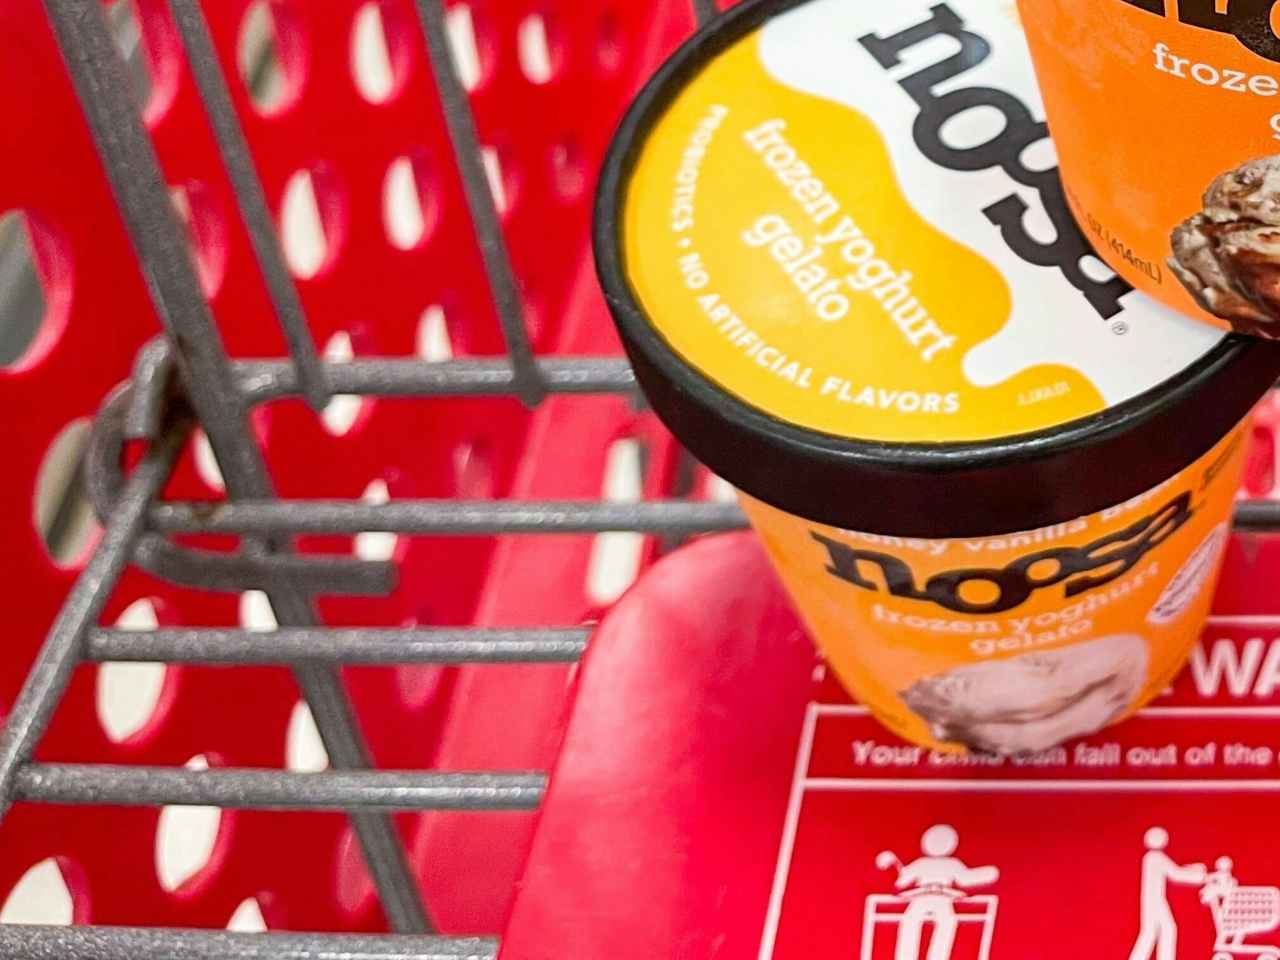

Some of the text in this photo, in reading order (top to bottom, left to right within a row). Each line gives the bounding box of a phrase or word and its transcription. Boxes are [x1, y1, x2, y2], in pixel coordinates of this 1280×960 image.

[671, 104, 961, 416] PROBIOTICS NO ARTIFICIAL FLAVORS
[741, 119, 959, 363] frozen yoghurt
[741, 212, 850, 323] gelato
[810, 489, 1195, 615] noosa
[869, 602, 1000, 634] frozen
[1005, 561, 1159, 638] yoghurt
[970, 619, 1093, 656] gelato
[853, 741, 920, 766] Your
[1075, 741, 1120, 766] fall
[1127, 743, 1177, 766] out
[1185, 741, 1215, 766] of
[1223, 741, 1272, 766] the
